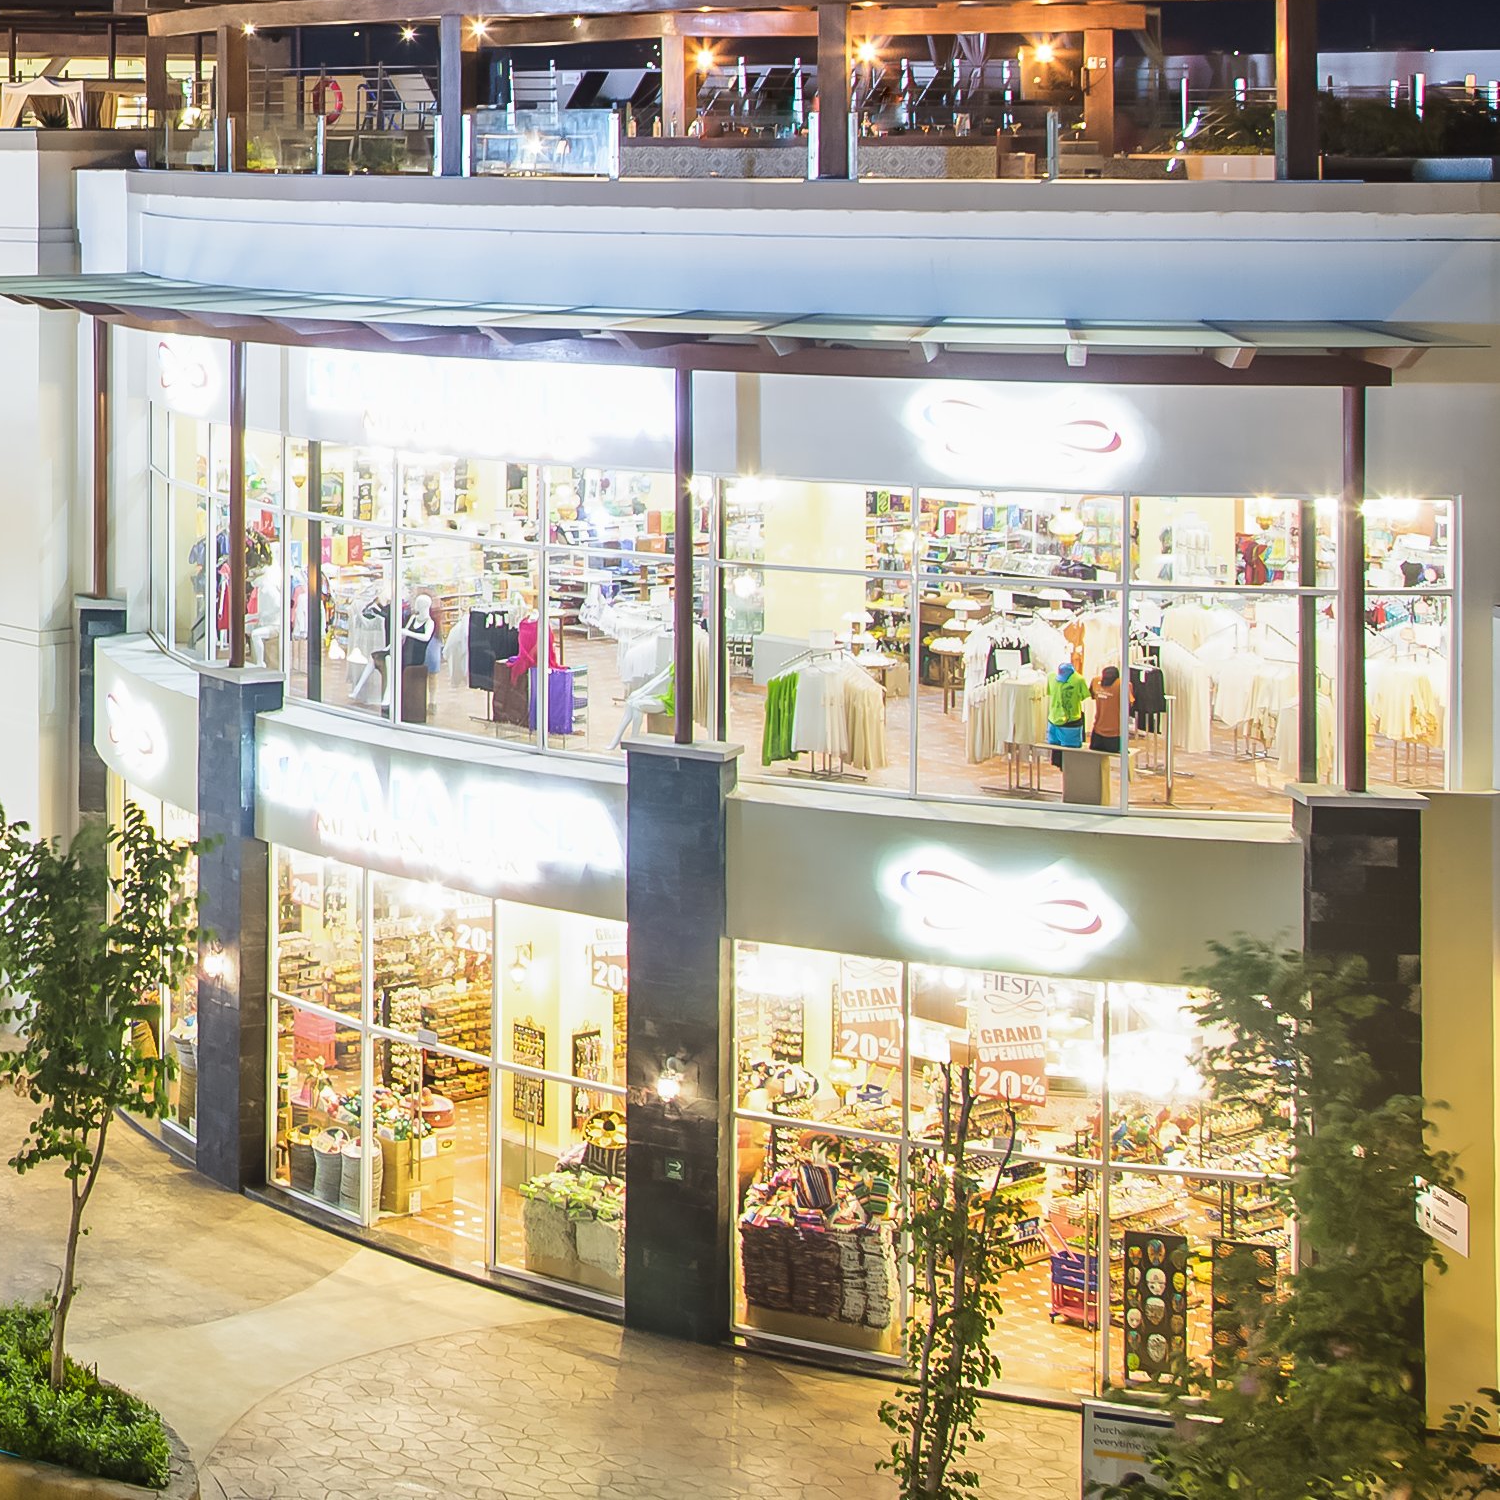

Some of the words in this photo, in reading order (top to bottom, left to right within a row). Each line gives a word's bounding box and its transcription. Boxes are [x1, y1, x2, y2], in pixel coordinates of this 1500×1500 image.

[842, 986, 898, 1008] GRAN
[983, 972, 1045, 998] FIESTA
[840, 1029, 901, 1062] 20%
[980, 1025, 1042, 1044] GRAND
[978, 1043, 1046, 1063] OPENING
[978, 1066, 1046, 1100] 20%
